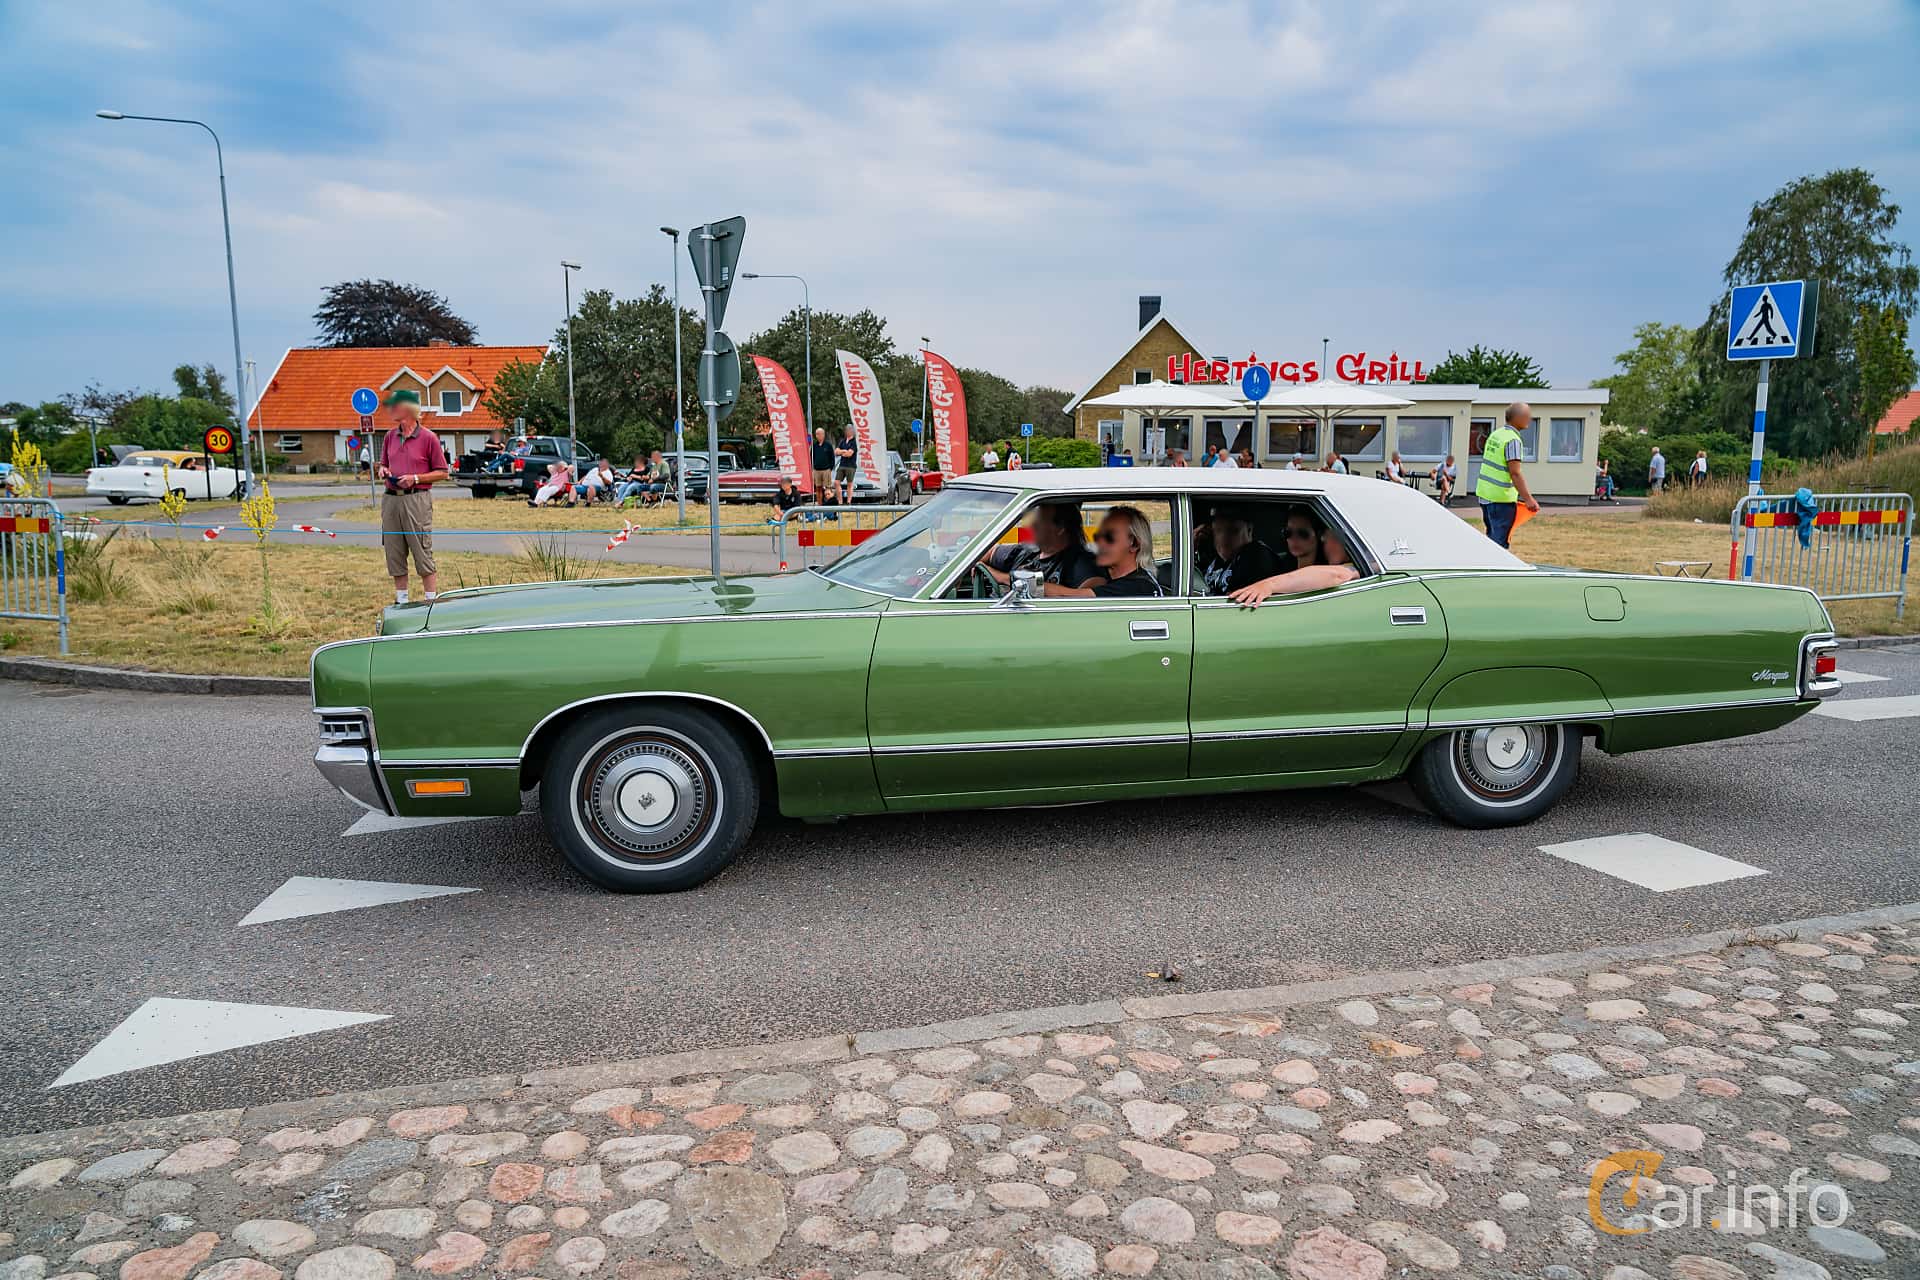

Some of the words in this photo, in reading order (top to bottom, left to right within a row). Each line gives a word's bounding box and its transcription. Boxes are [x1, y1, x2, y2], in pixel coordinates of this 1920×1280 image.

[1167, 351, 1319, 384] HERTNGS
[1335, 350, 1428, 385] GRILL
[210, 434, 229, 447] 30
